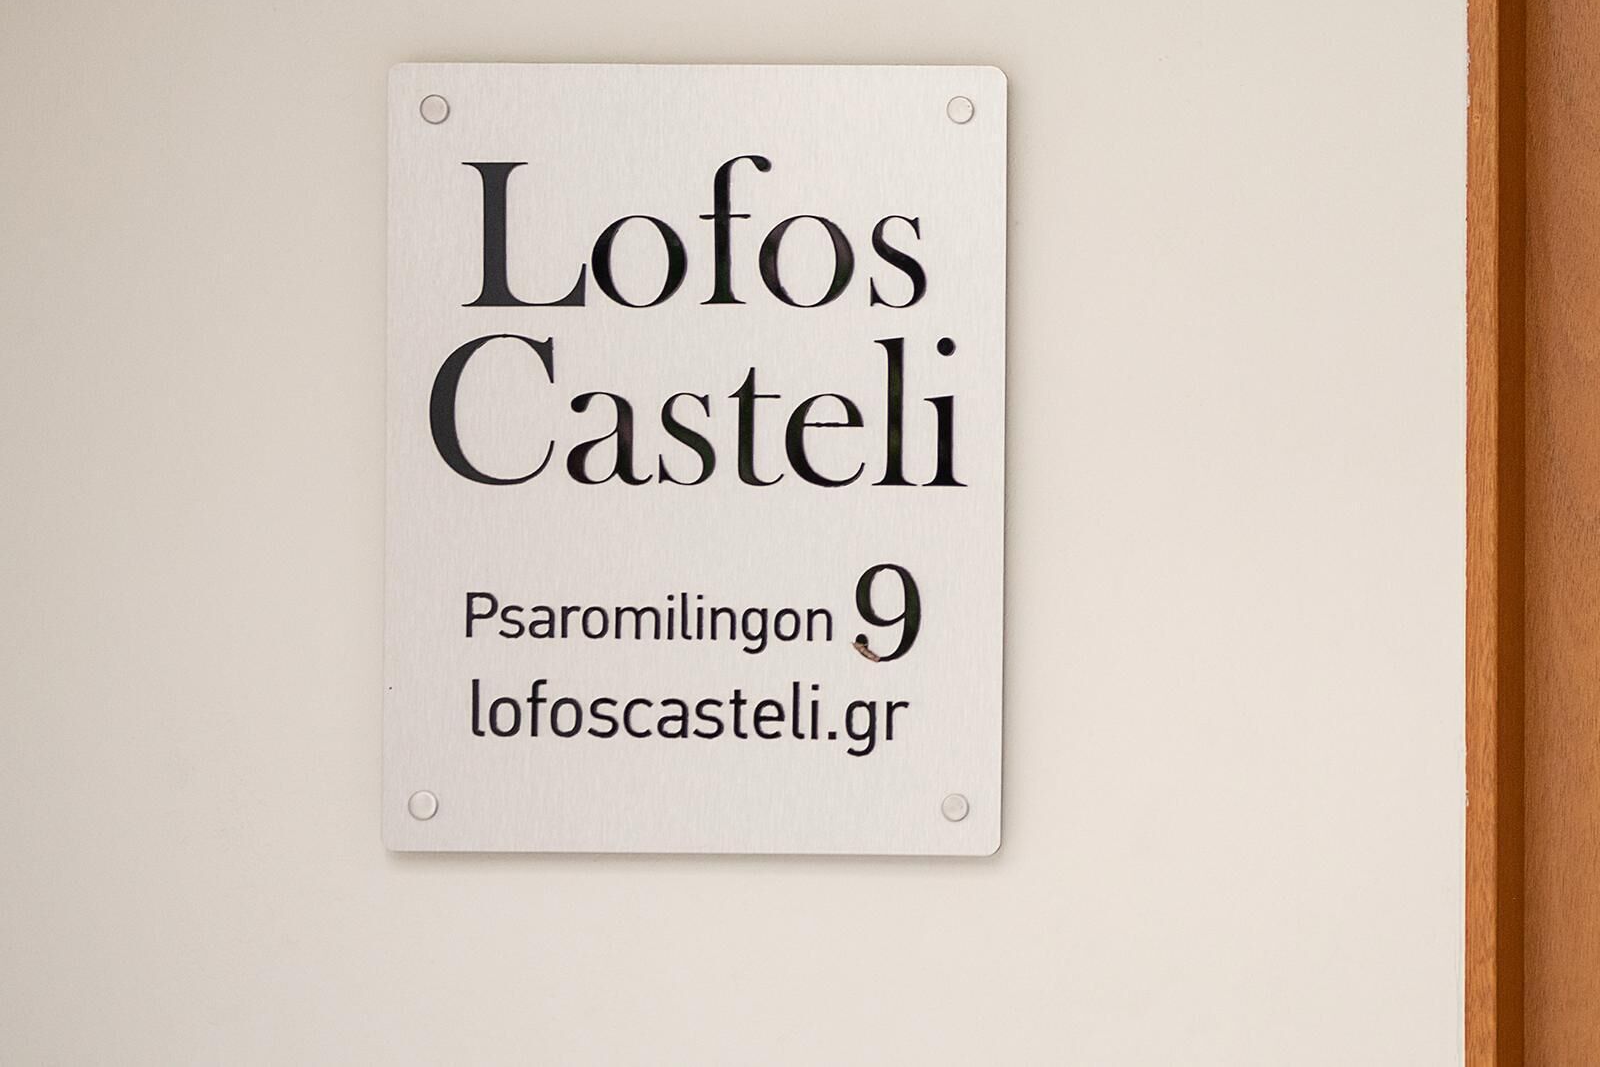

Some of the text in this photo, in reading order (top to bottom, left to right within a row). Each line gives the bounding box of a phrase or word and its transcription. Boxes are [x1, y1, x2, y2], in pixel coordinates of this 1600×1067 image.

[460, 154, 928, 309] Lofos
[428, 332, 969, 489] Casteli
[465, 562, 923, 664] Psaromilingon 9
[470, 677, 911, 758] lofoscasteli.gr
